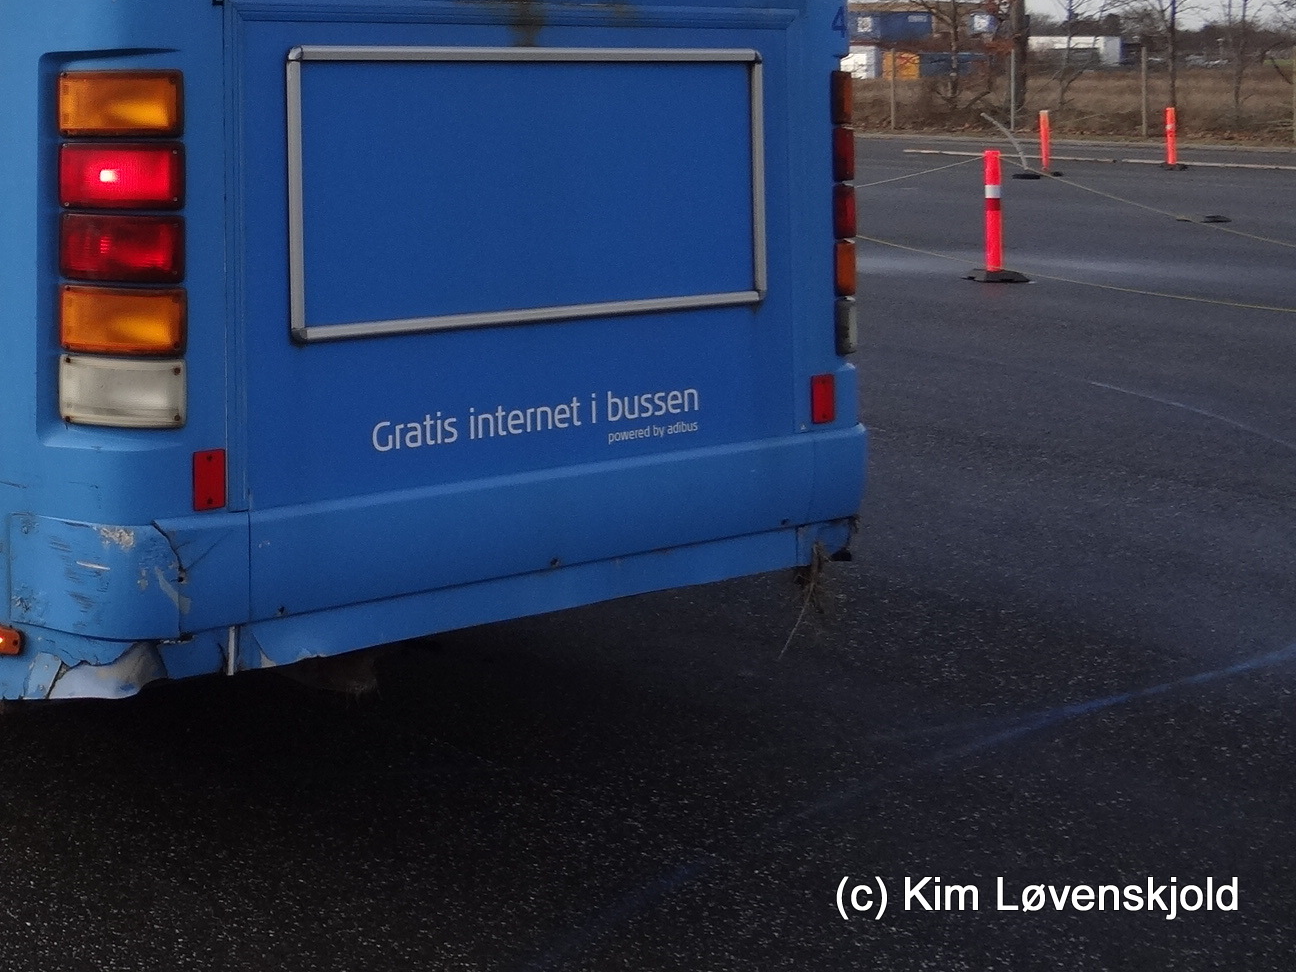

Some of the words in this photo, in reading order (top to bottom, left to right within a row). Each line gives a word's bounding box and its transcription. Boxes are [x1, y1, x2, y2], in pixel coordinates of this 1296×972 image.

[372, 411, 458, 452] Gratis
[469, 396, 582, 440] internet
[591, 393, 597, 424] i
[607, 388, 699, 422] bussen
[608, 426, 650, 445] powered
[653, 425, 665, 438] by
[667, 421, 698, 435] adibus
